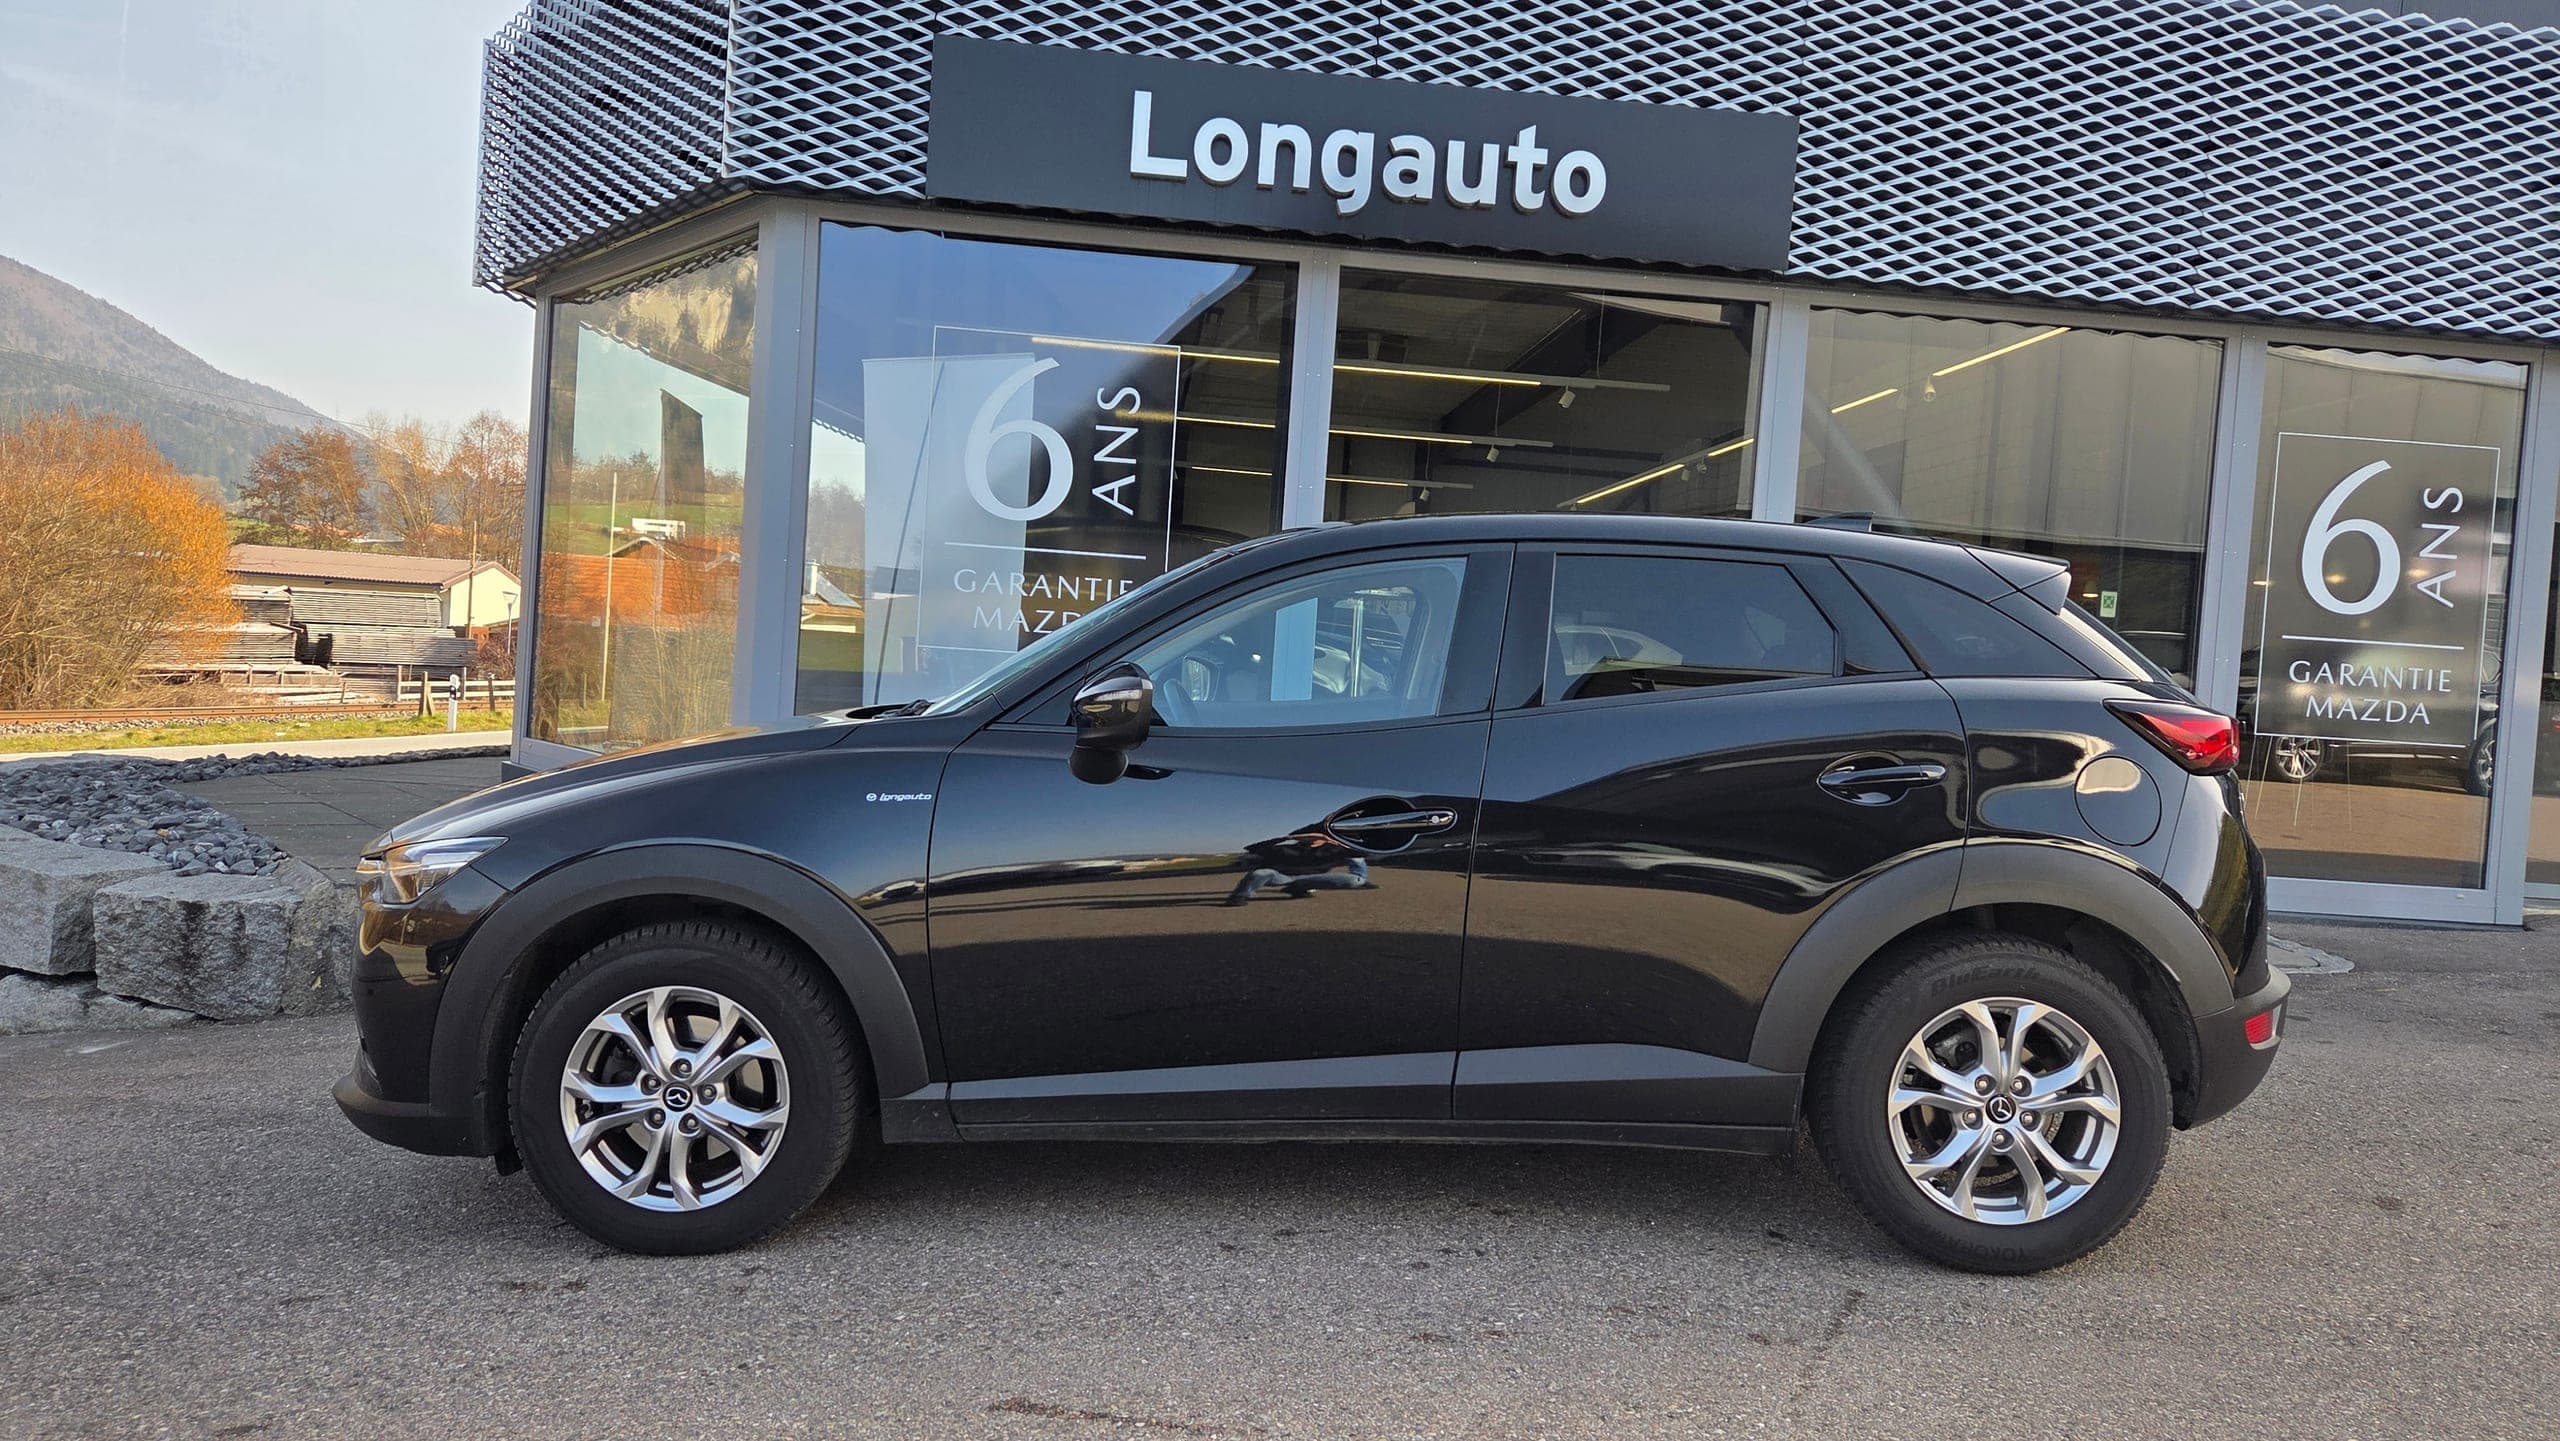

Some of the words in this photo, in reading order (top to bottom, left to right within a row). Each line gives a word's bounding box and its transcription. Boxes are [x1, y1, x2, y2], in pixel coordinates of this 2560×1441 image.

[1129, 89, 1607, 217] Longauto
[964, 357, 1074, 521] 6
[1092, 386, 1141, 516] ANS
[2302, 459, 2401, 615] 6
[2417, 487, 2463, 608] ANS
[2288, 660, 2452, 692] GARANTIE
[2305, 695, 2431, 725] MAZDA
